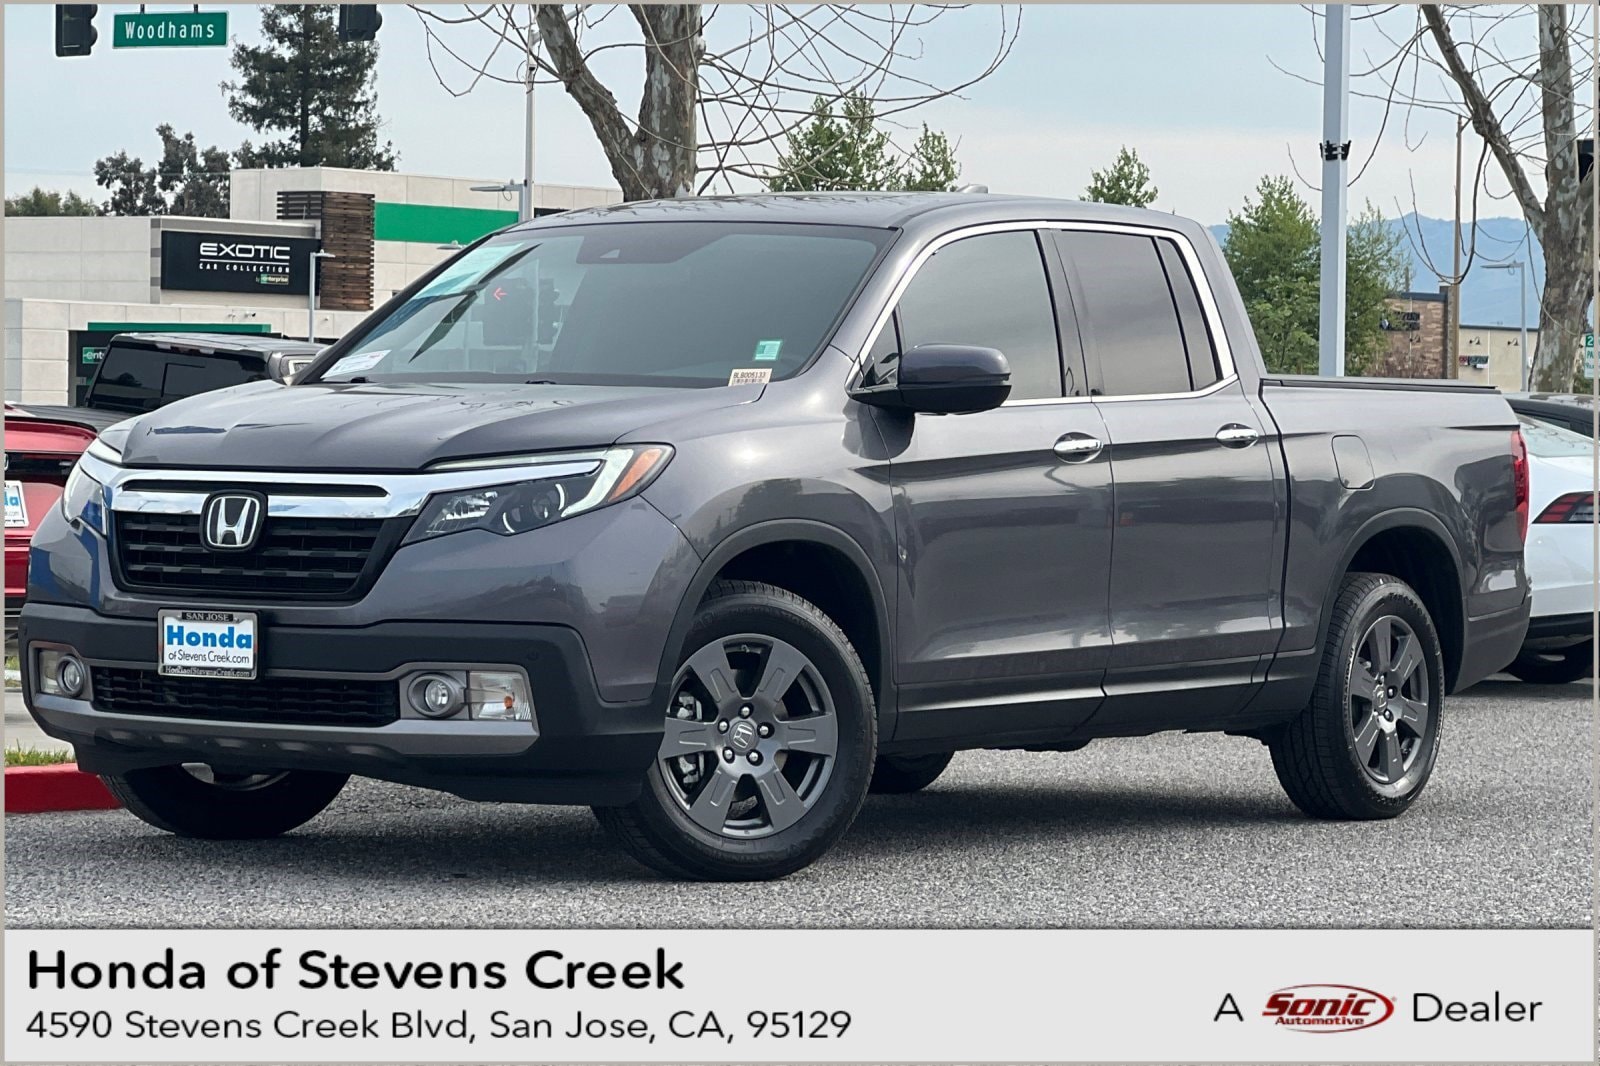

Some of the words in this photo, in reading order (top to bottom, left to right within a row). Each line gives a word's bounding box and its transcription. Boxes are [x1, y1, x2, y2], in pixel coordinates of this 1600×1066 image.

[125, 21, 215, 39] Woodhams
[200, 243, 290, 259] EXOTIC
[226, 264, 290, 273] COLLECTION
[186, 612, 204, 620] SAN
[205, 613, 230, 621] JOSE
[166, 625, 253, 649] Honda
[168, 650, 177, 661] of
